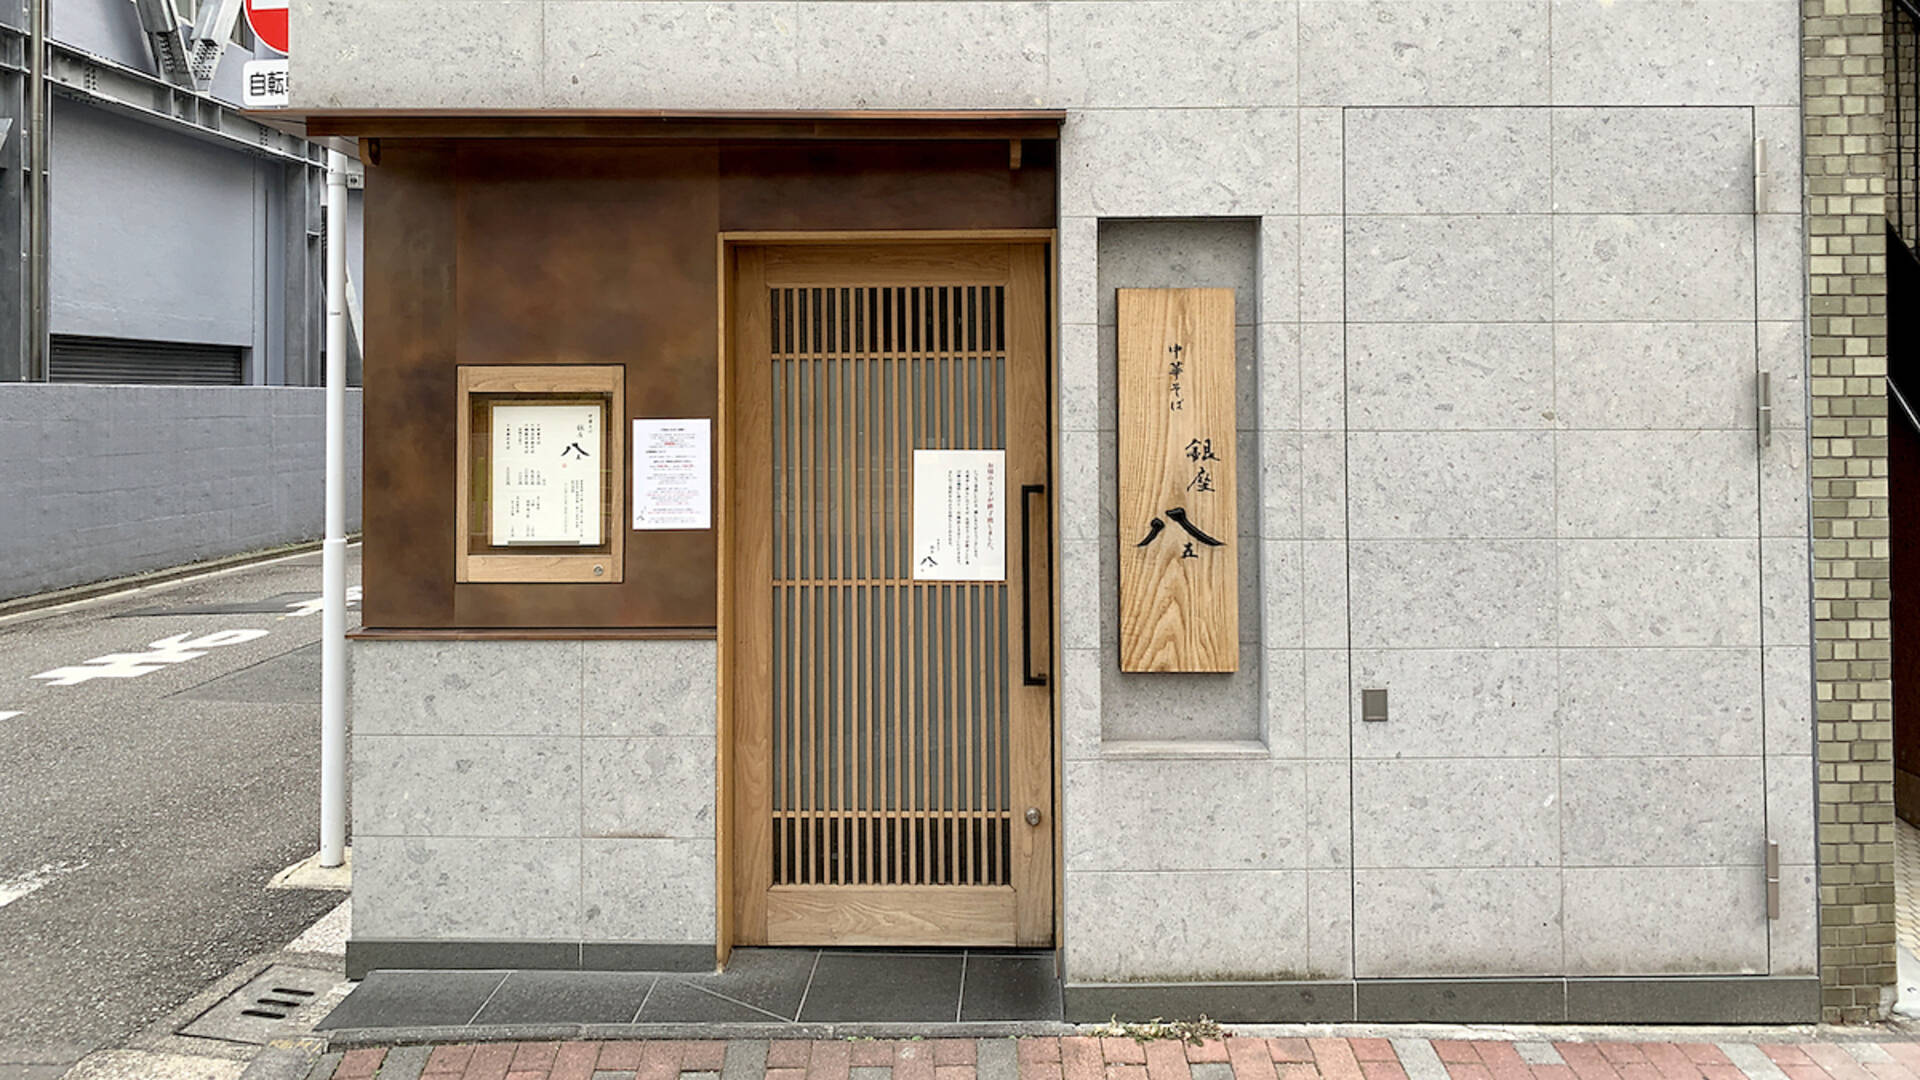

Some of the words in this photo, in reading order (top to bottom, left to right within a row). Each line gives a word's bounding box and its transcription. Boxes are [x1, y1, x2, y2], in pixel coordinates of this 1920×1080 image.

[250, 71, 288, 96] 自転
[1168, 343, 1184, 412] 中華そば
[1185, 438, 1220, 493] 銀座
